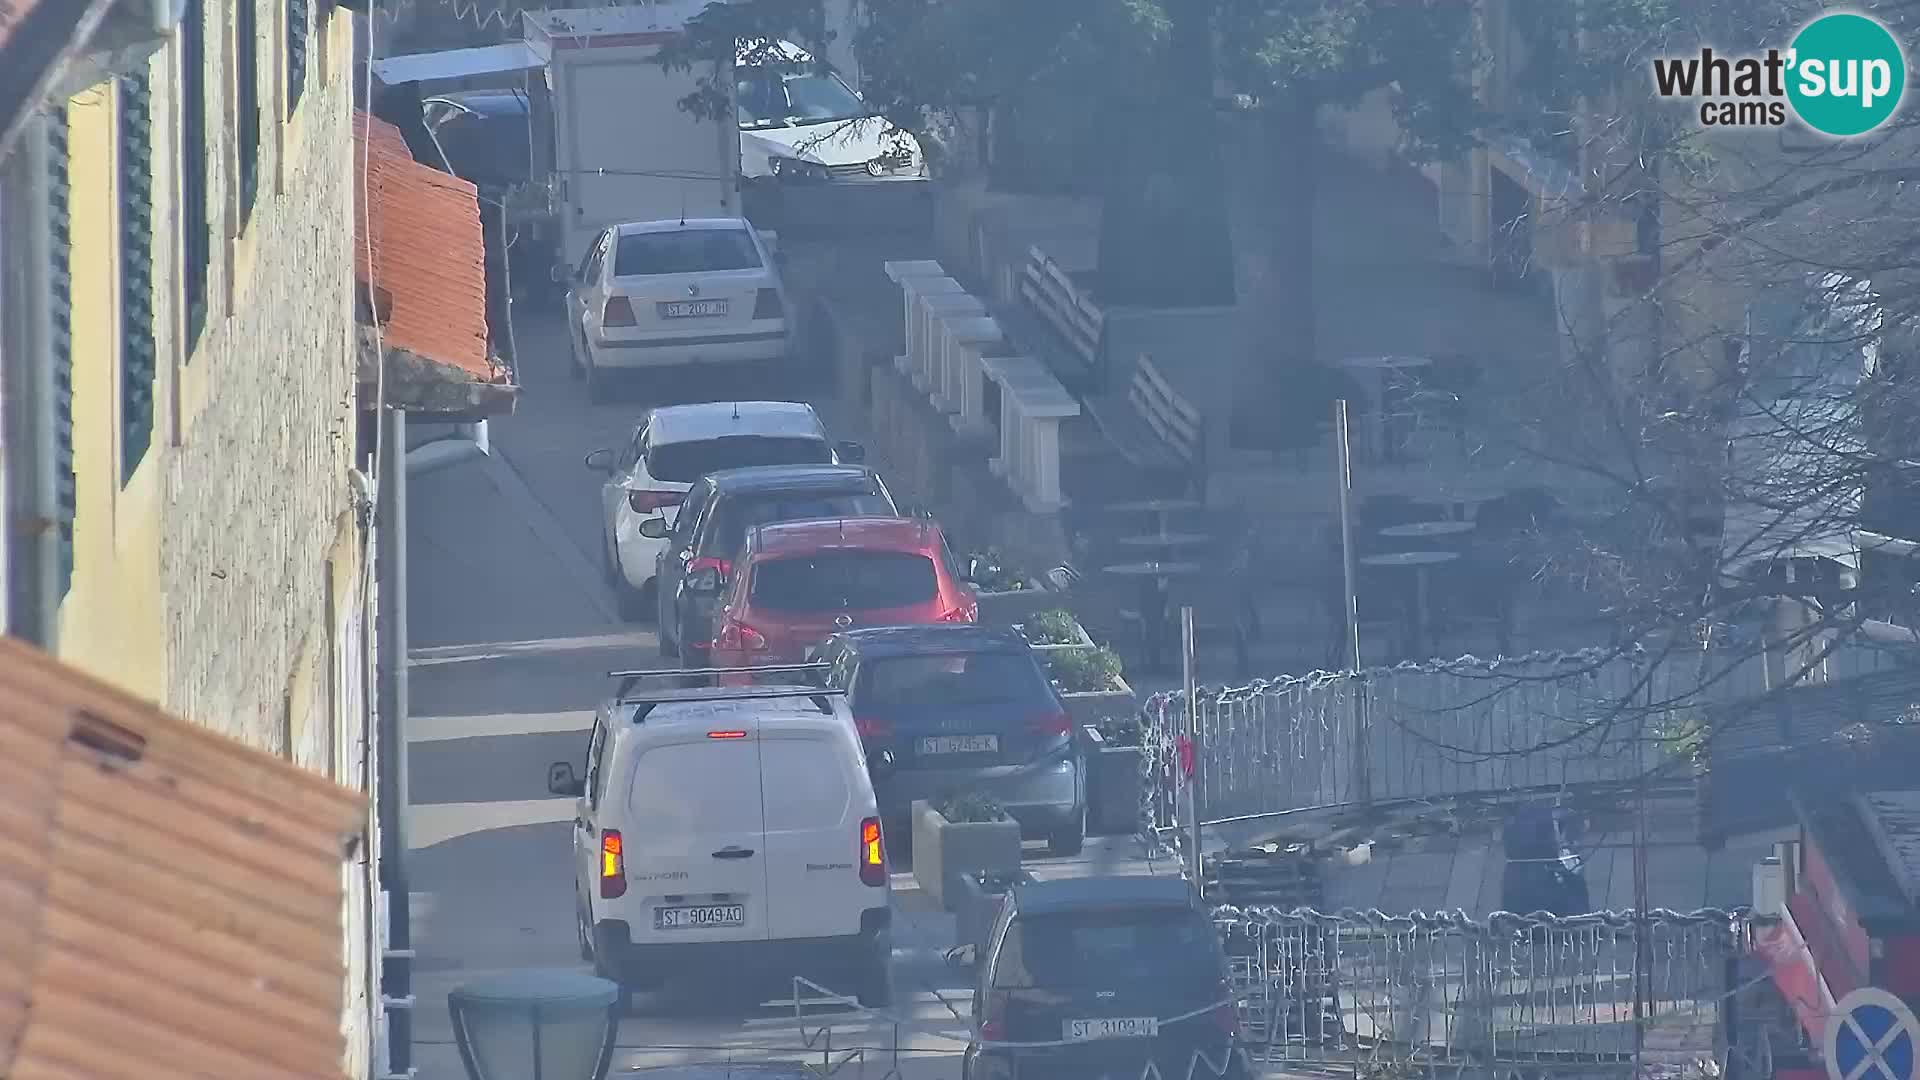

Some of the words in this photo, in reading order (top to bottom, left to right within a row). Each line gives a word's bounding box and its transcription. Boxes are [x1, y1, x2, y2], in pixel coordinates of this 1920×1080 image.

[668, 303, 680, 315] ST
[664, 910, 681, 924] ST
[1073, 1022, 1089, 1037] ST
